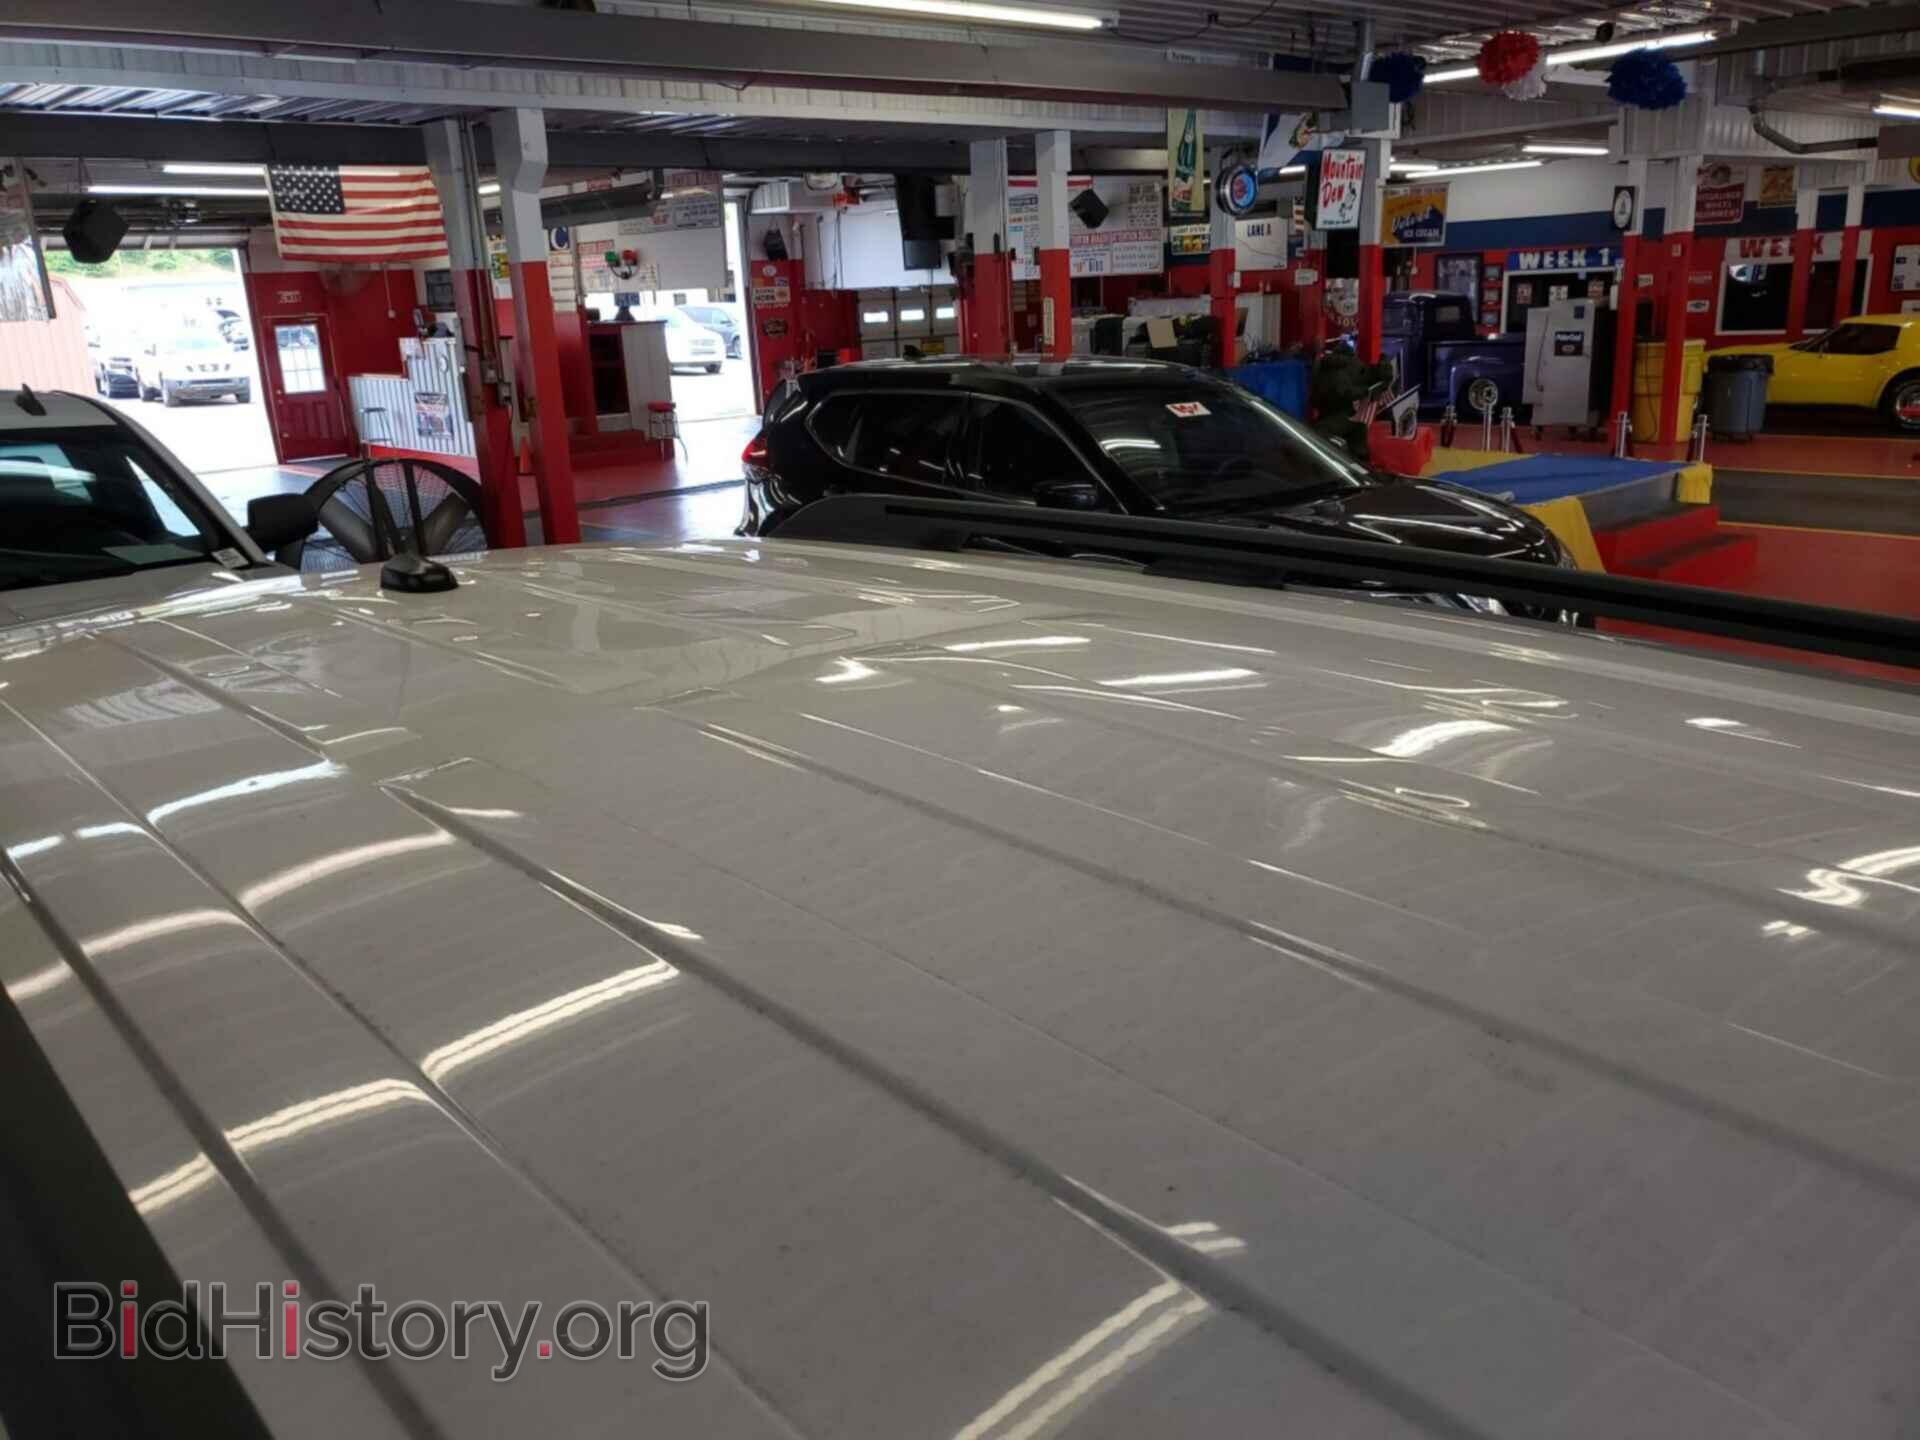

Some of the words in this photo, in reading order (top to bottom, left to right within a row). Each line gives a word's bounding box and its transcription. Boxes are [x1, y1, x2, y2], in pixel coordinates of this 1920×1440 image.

[1322, 152, 1363, 180] Mountain
[1321, 182, 1344, 208] Dew
[1247, 224, 1264, 236] LANE
[1519, 249, 1586, 269] WEEK
[1599, 247, 1610, 266] 1
